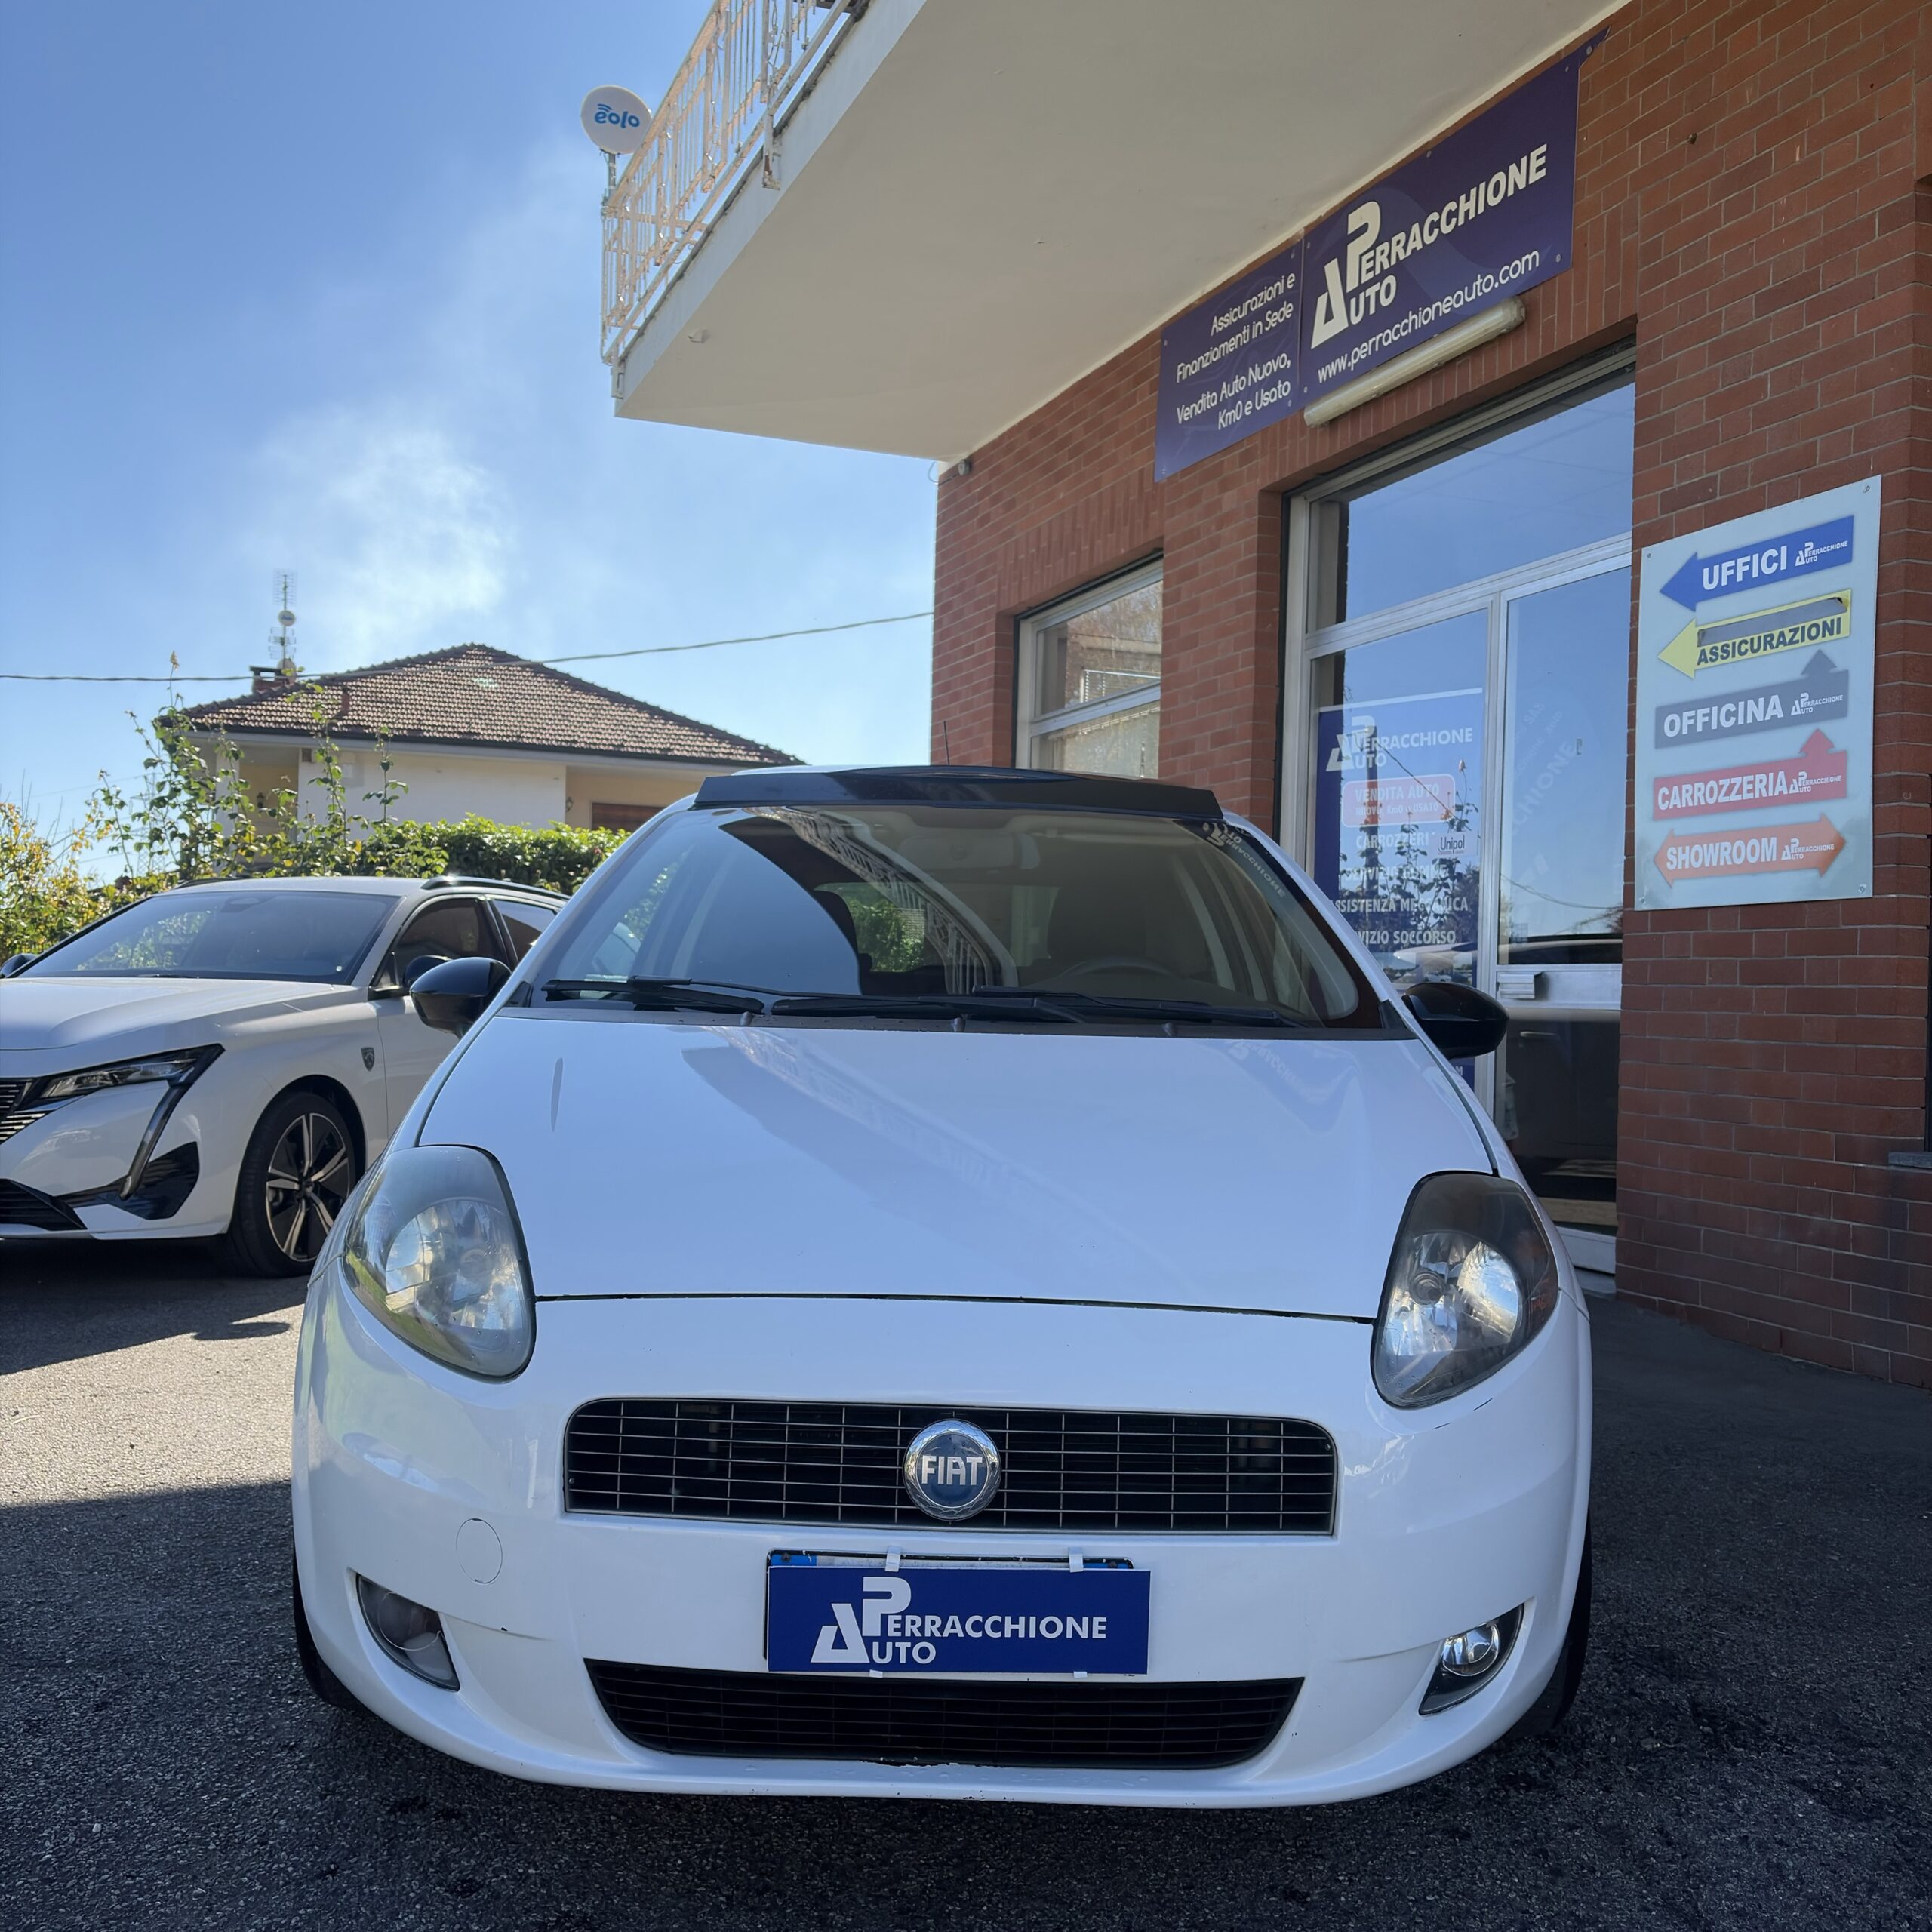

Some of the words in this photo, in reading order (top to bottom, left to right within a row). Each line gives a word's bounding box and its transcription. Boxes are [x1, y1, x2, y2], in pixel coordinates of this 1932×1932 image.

[594, 111, 640, 128] eolo
[1346, 144, 1547, 293] PERRACCHIONE
[1211, 275, 1284, 336] Assicurazioni
[1287, 273, 1296, 288] e
[1311, 258, 1397, 349] AUTO
[1318, 251, 1540, 383] www.perracchioneauto.com
[1177, 325, 1250, 383] Finanziamenti
[1252, 321, 1263, 339] in
[1264, 301, 1294, 331] Sede
[1177, 392, 1217, 424] Vendita
[1220, 375, 1246, 402] Auto
[1248, 353, 1291, 386] Nuovo,
[1218, 401, 1242, 430] Km0
[1244, 400, 1252, 415] e
[1255, 380, 1291, 410] Usato
[1795, 550, 1818, 566] AUTO
[1804, 541, 1848, 557] PERRACCHIONE
[1703, 546, 1788, 590] UFFICI
[1697, 617, 1841, 666] ASSICURAZIONI
[1663, 694, 1783, 737] OFFICINA
[1791, 700, 1813, 716] AUTO
[1800, 692, 1843, 708] PERRACCHIONE
[1351, 715, 1472, 752] PERRACCHIONE
[1325, 734, 1386, 771] AUTO
[1355, 787, 1404, 801] VENDITA
[1407, 783, 1440, 799] AUTO
[1512, 740, 1577, 835] CHIONE
[1657, 771, 1788, 811] CARROZZERIA
[1789, 779, 1811, 793] AUTO
[1798, 771, 1842, 787] PERRACCHIONE
[1356, 832, 1434, 848] CARROZZERI
[1440, 835, 1465, 854] Unipol
[1666, 837, 1777, 870] SHOWROOM
[1781, 846, 1804, 860] AUTO
[1790, 838, 1835, 853] PERRACCHIONE
[1333, 898, 1396, 913] SSISTENZA
[1358, 930, 1389, 945] VIZIO
[1393, 930, 1456, 944] SOCCORSO
[921, 1455, 983, 1486] FIAT
[863, 1577, 1106, 1640] PERRACCHIONE
[811, 1603, 937, 1665] AUTO
